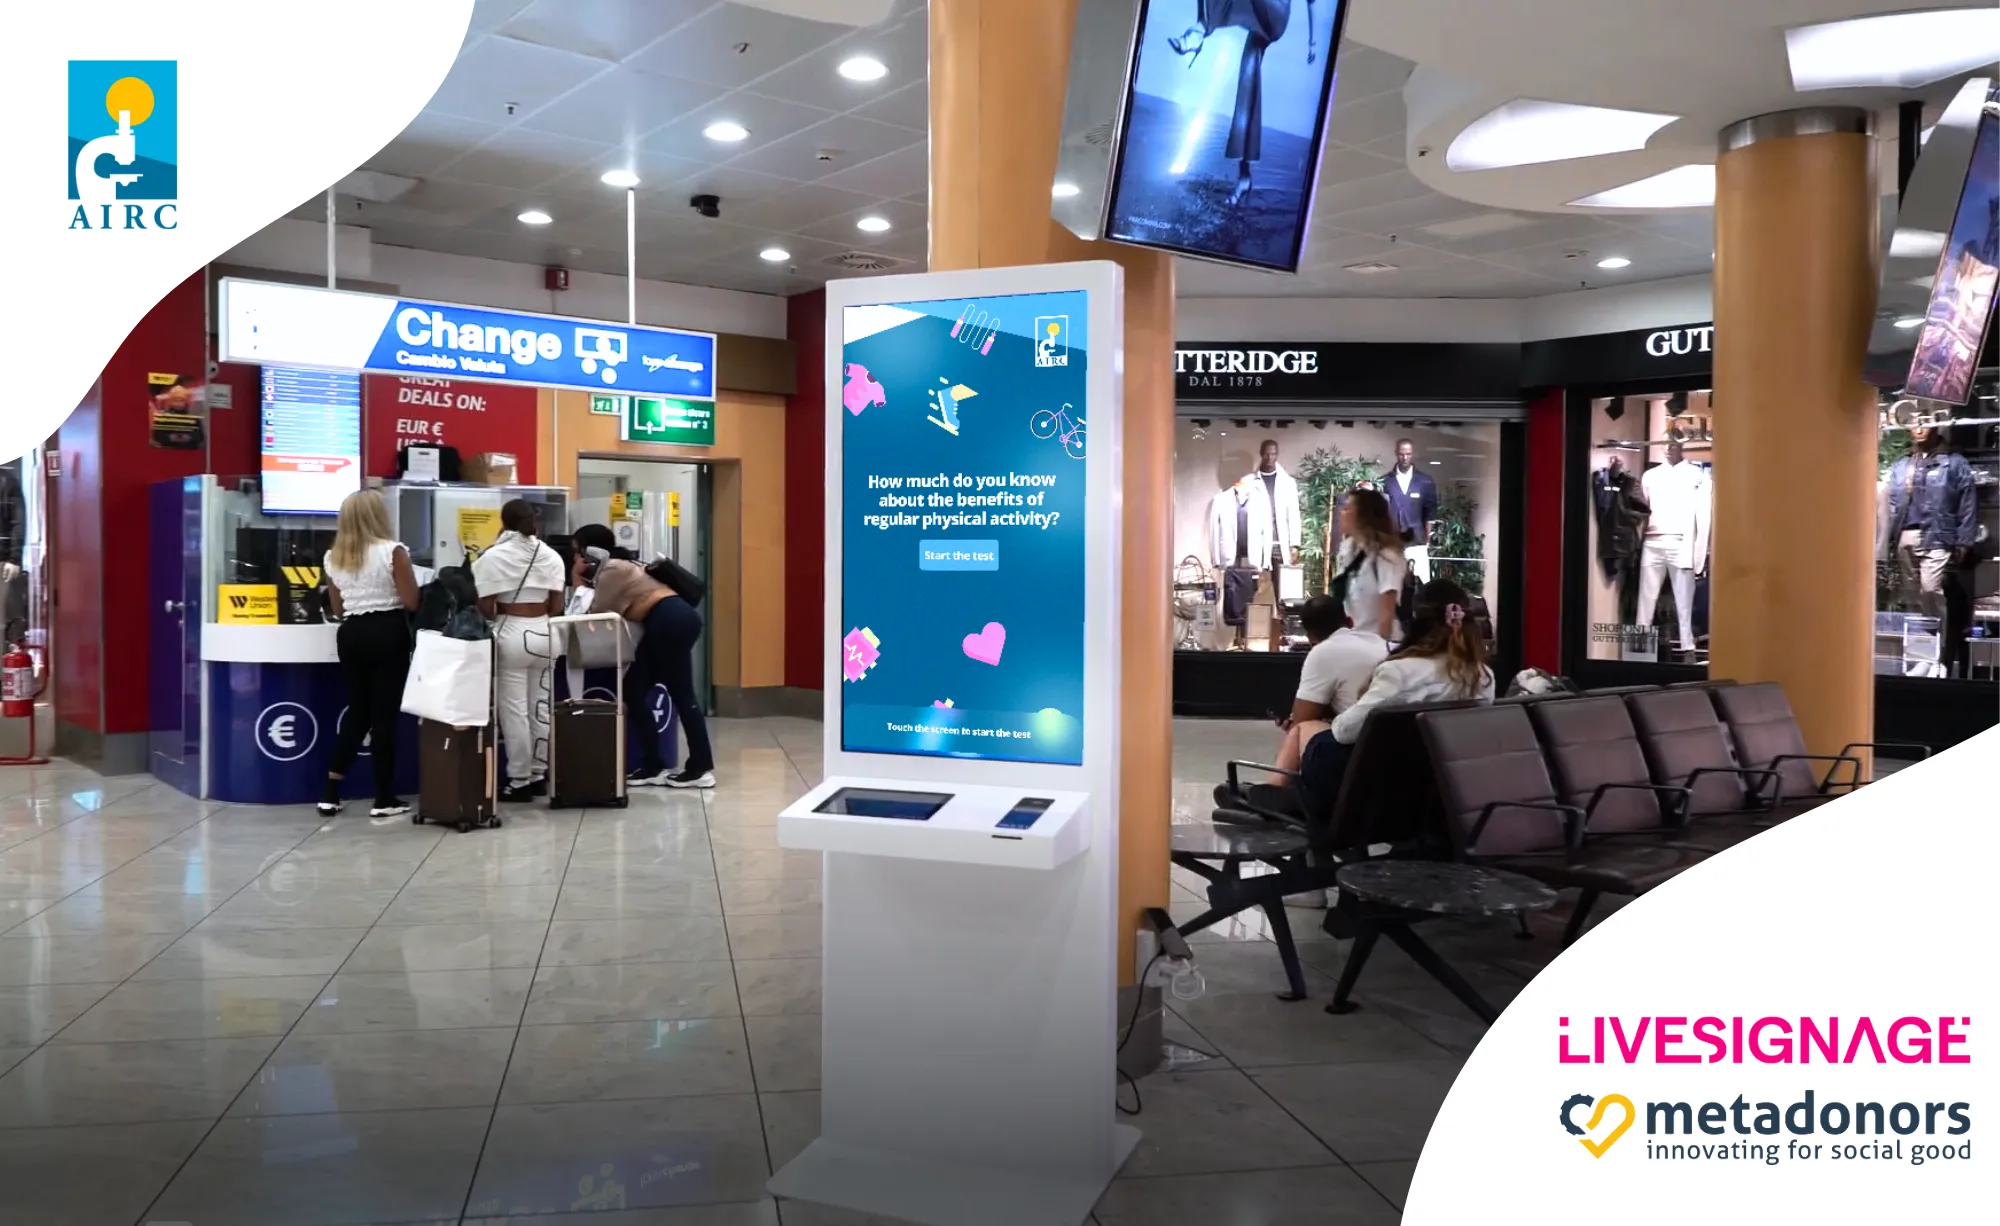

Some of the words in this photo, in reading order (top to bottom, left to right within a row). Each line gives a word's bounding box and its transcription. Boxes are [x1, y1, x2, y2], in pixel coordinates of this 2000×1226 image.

[396, 307, 562, 365] Change
[1646, 327, 1714, 357] GUT
[396, 350, 457, 370] Cambio
[459, 356, 506, 375] Valuta
[1036, 356, 1066, 366] AIRC
[1174, 350, 1318, 374] TTERIDGE
[1189, 376, 1222, 387] DAL
[1229, 376, 1262, 387] 1878
[398, 387, 454, 408] DEALS
[456, 393, 487, 412] ON:
[396, 418, 430, 435] EUR
[432, 421, 445, 437] €
[868, 474, 903, 489] How
[906, 472, 950, 489] much
[953, 472, 973, 488] do
[976, 474, 1006, 491] you
[1009, 472, 1057, 487] know
[879, 493, 925, 508] about
[927, 492, 954, 507] the
[957, 491, 1024, 507] benefits
[1026, 491, 1046, 506] of
[864, 511, 920, 530] regular
[922, 511, 987, 530] physical
[990, 510, 1061, 530] activity?
[924, 550, 951, 561] Start
[953, 551, 971, 561] the
[972, 551, 994, 561] test
[1592, 622, 1621, 633] SHOP
[268, 714, 297, 748] €
[887, 722, 913, 732] Touch
[914, 723, 930, 733] the
[930, 726, 960, 735] screen
[961, 727, 971, 736] to
[972, 728, 995, 737] start
[996, 728, 1012, 738] the
[1013, 730, 1031, 739] test
